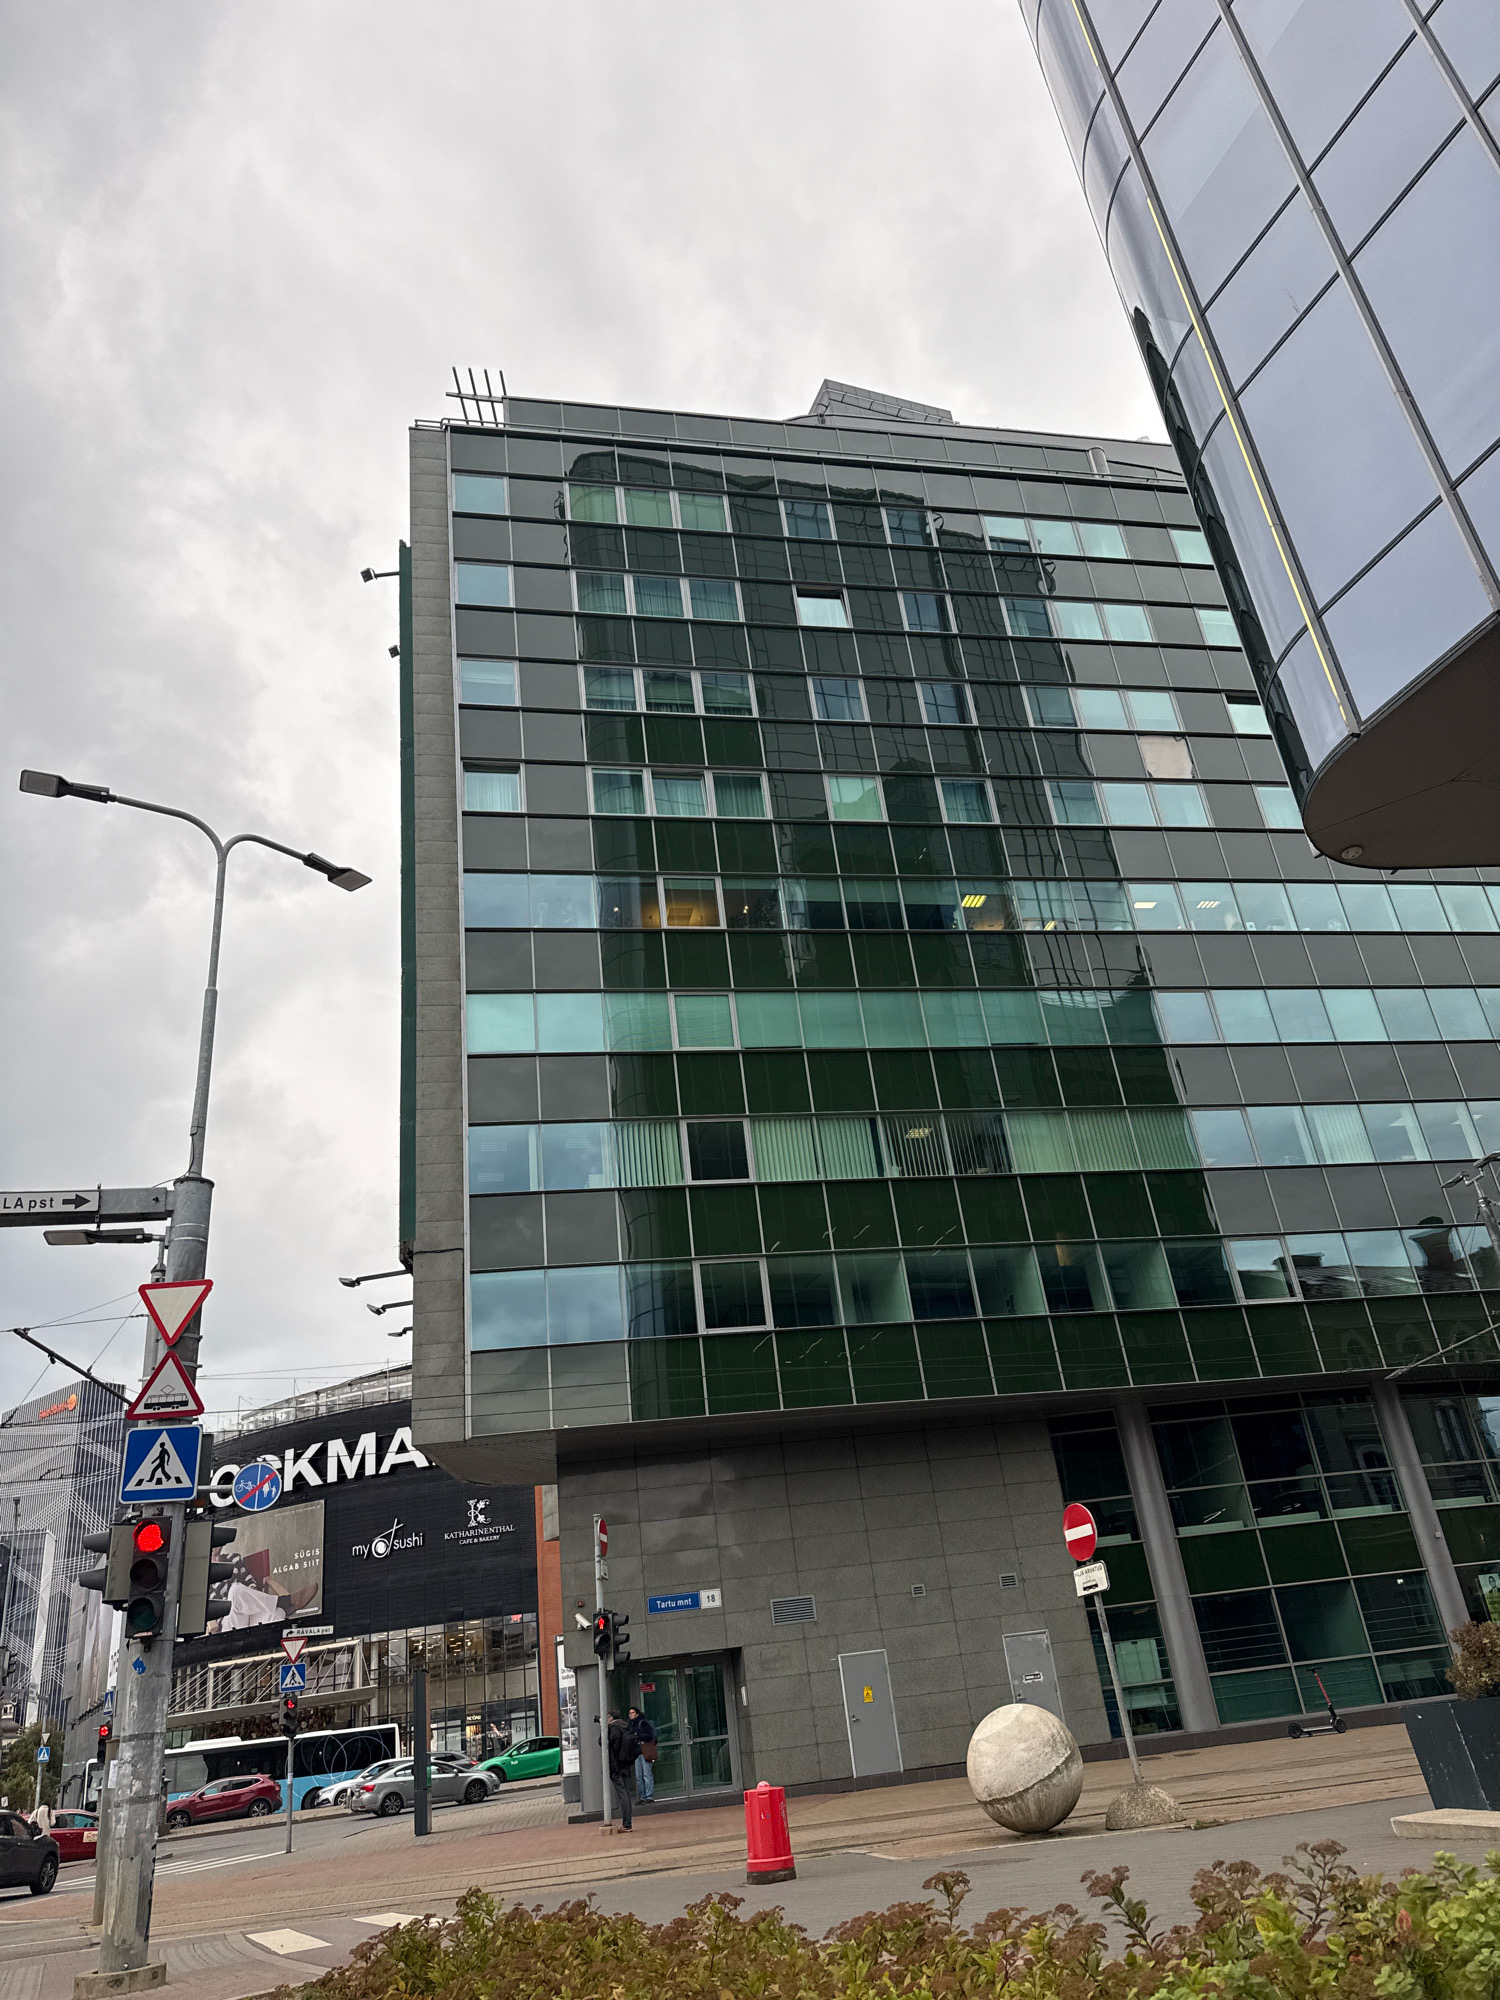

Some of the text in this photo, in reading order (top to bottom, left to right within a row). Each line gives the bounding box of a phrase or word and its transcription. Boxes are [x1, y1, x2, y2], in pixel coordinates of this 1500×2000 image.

[28, 1197, 54, 1212] pst
[444, 1524, 516, 1540] KATHARINENTHAL
[479, 1535, 500, 1543] BAKERY
[272, 1559, 320, 1575] ALGAB SIIT
[656, 1597, 692, 1609] Tartu mnt
[706, 1594, 716, 1603] 18
